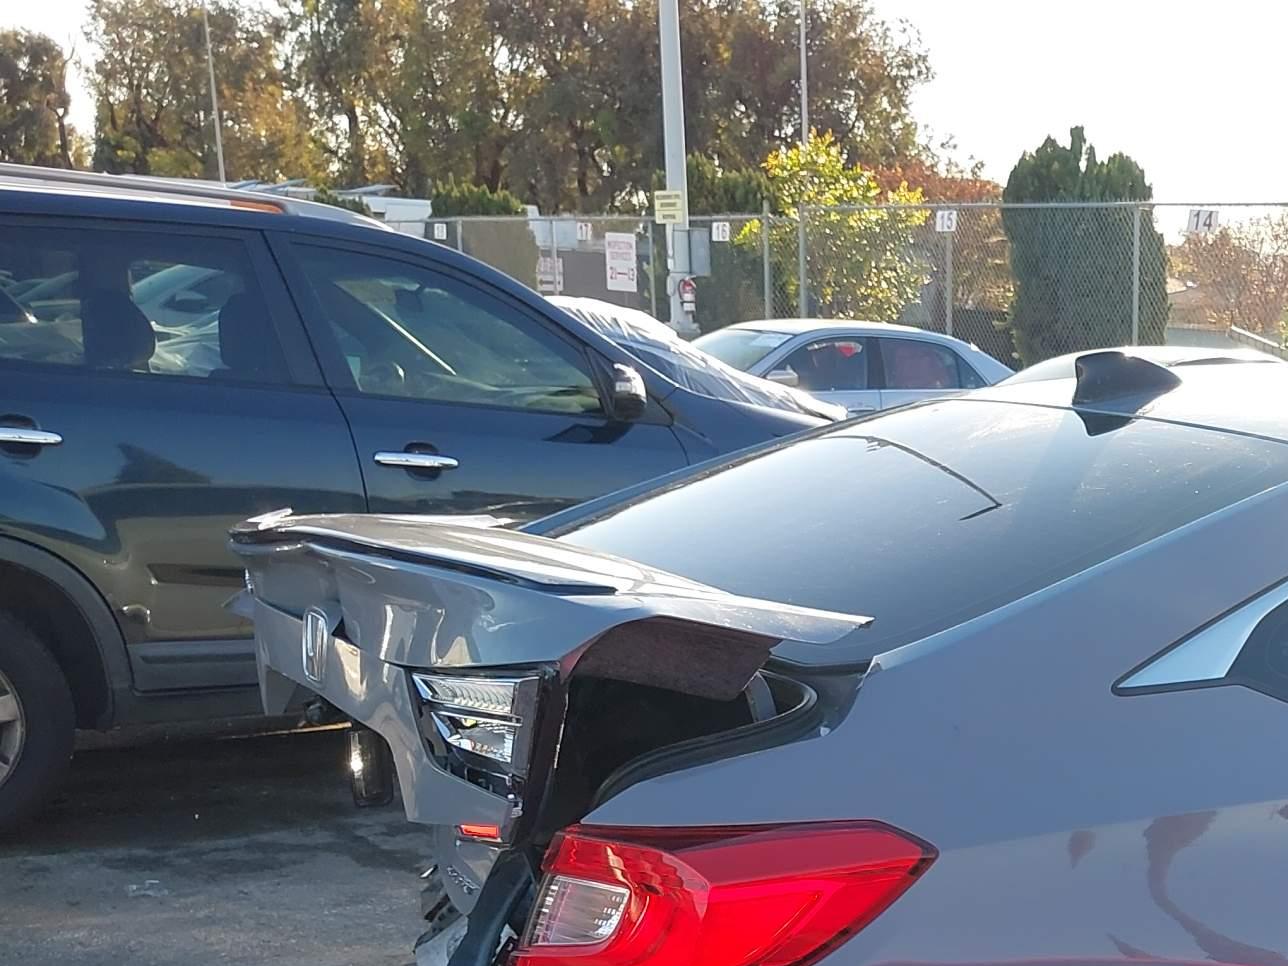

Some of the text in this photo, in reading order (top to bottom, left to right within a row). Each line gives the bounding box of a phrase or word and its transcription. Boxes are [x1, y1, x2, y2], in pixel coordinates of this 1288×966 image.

[940, 211, 953, 230] 15
[1193, 210, 1213, 231] 14
[716, 223, 728, 240] 16
